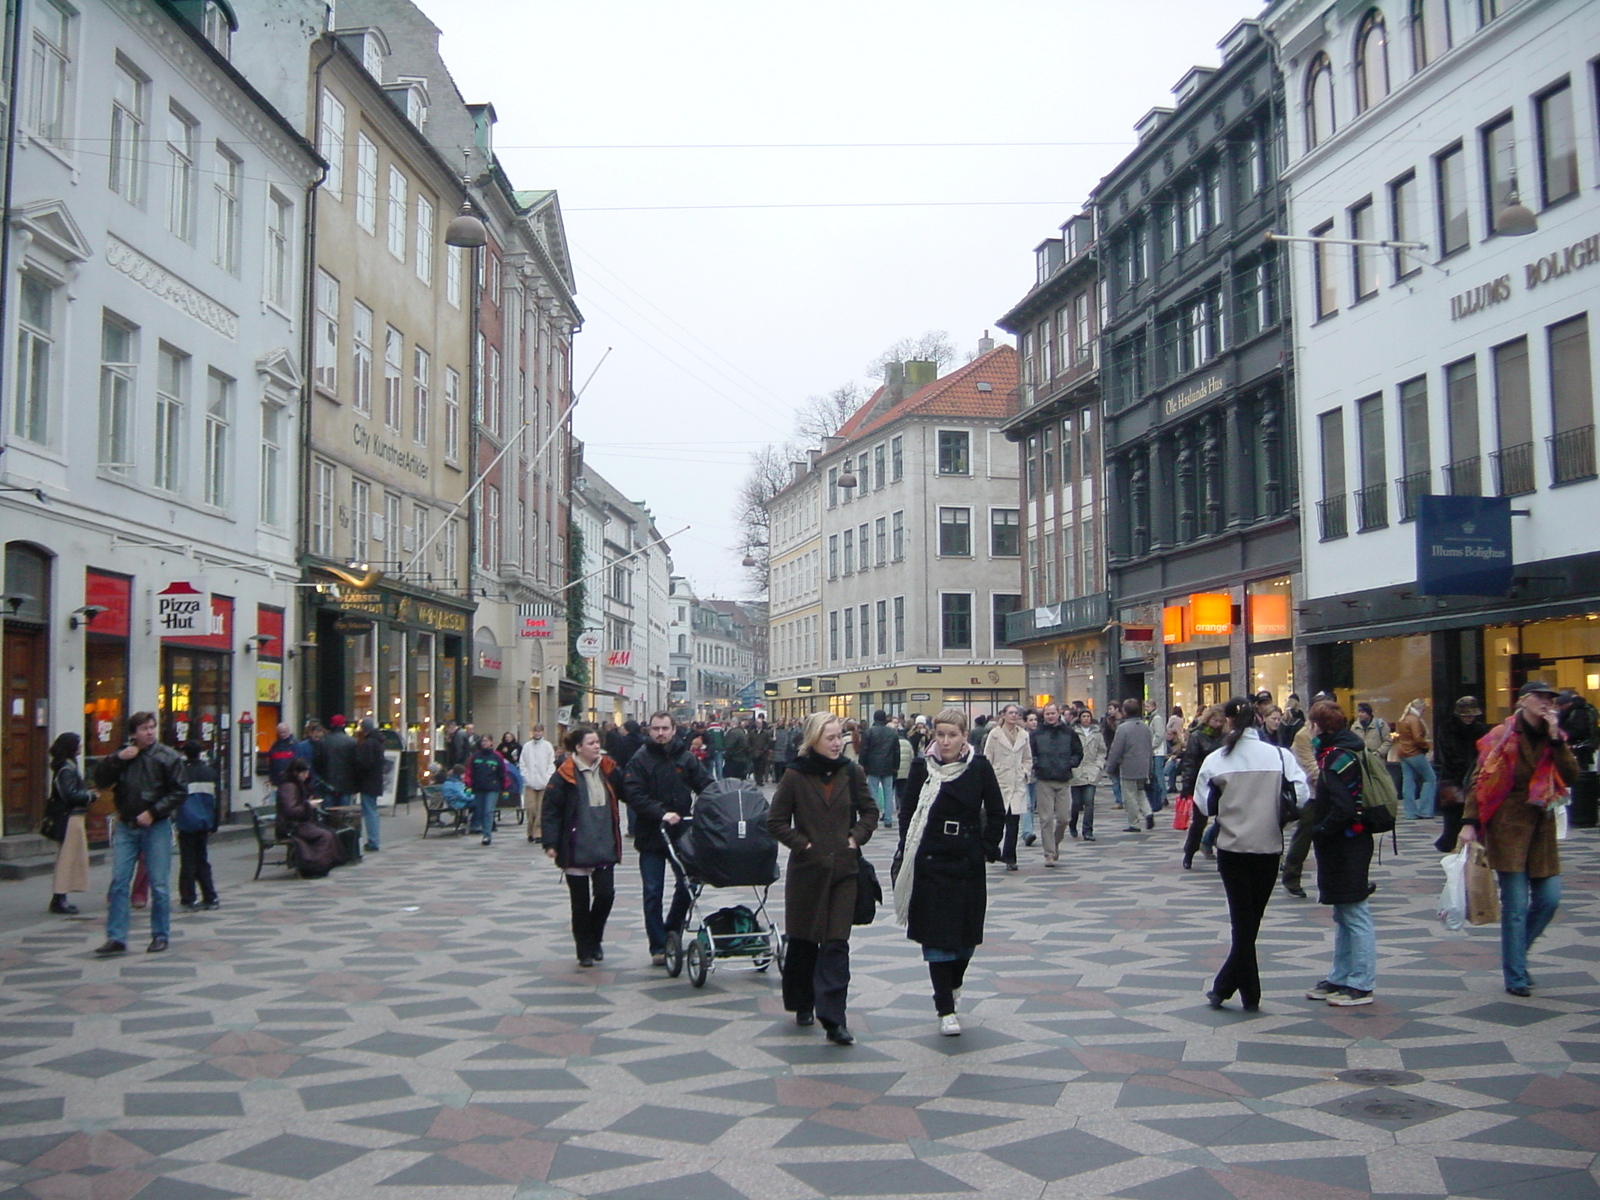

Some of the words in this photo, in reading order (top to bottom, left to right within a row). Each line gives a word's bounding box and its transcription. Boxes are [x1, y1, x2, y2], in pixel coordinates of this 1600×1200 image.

[1450, 273, 1511, 322] ILLUMS
[1165, 397, 1178, 415] Ole
[1208, 376, 1223, 394] Hus
[353, 423, 371, 454] City
[1432, 545, 1463, 557] Illums
[1464, 546, 1506, 560] Bolighus
[159, 598, 200, 615] Pizza
[160, 613, 195, 629] Hut
[525, 618, 546, 627] Foot
[1195, 623, 1228, 633] orange
[521, 629, 551, 638] Locker
[608, 651, 631, 666] H&M
